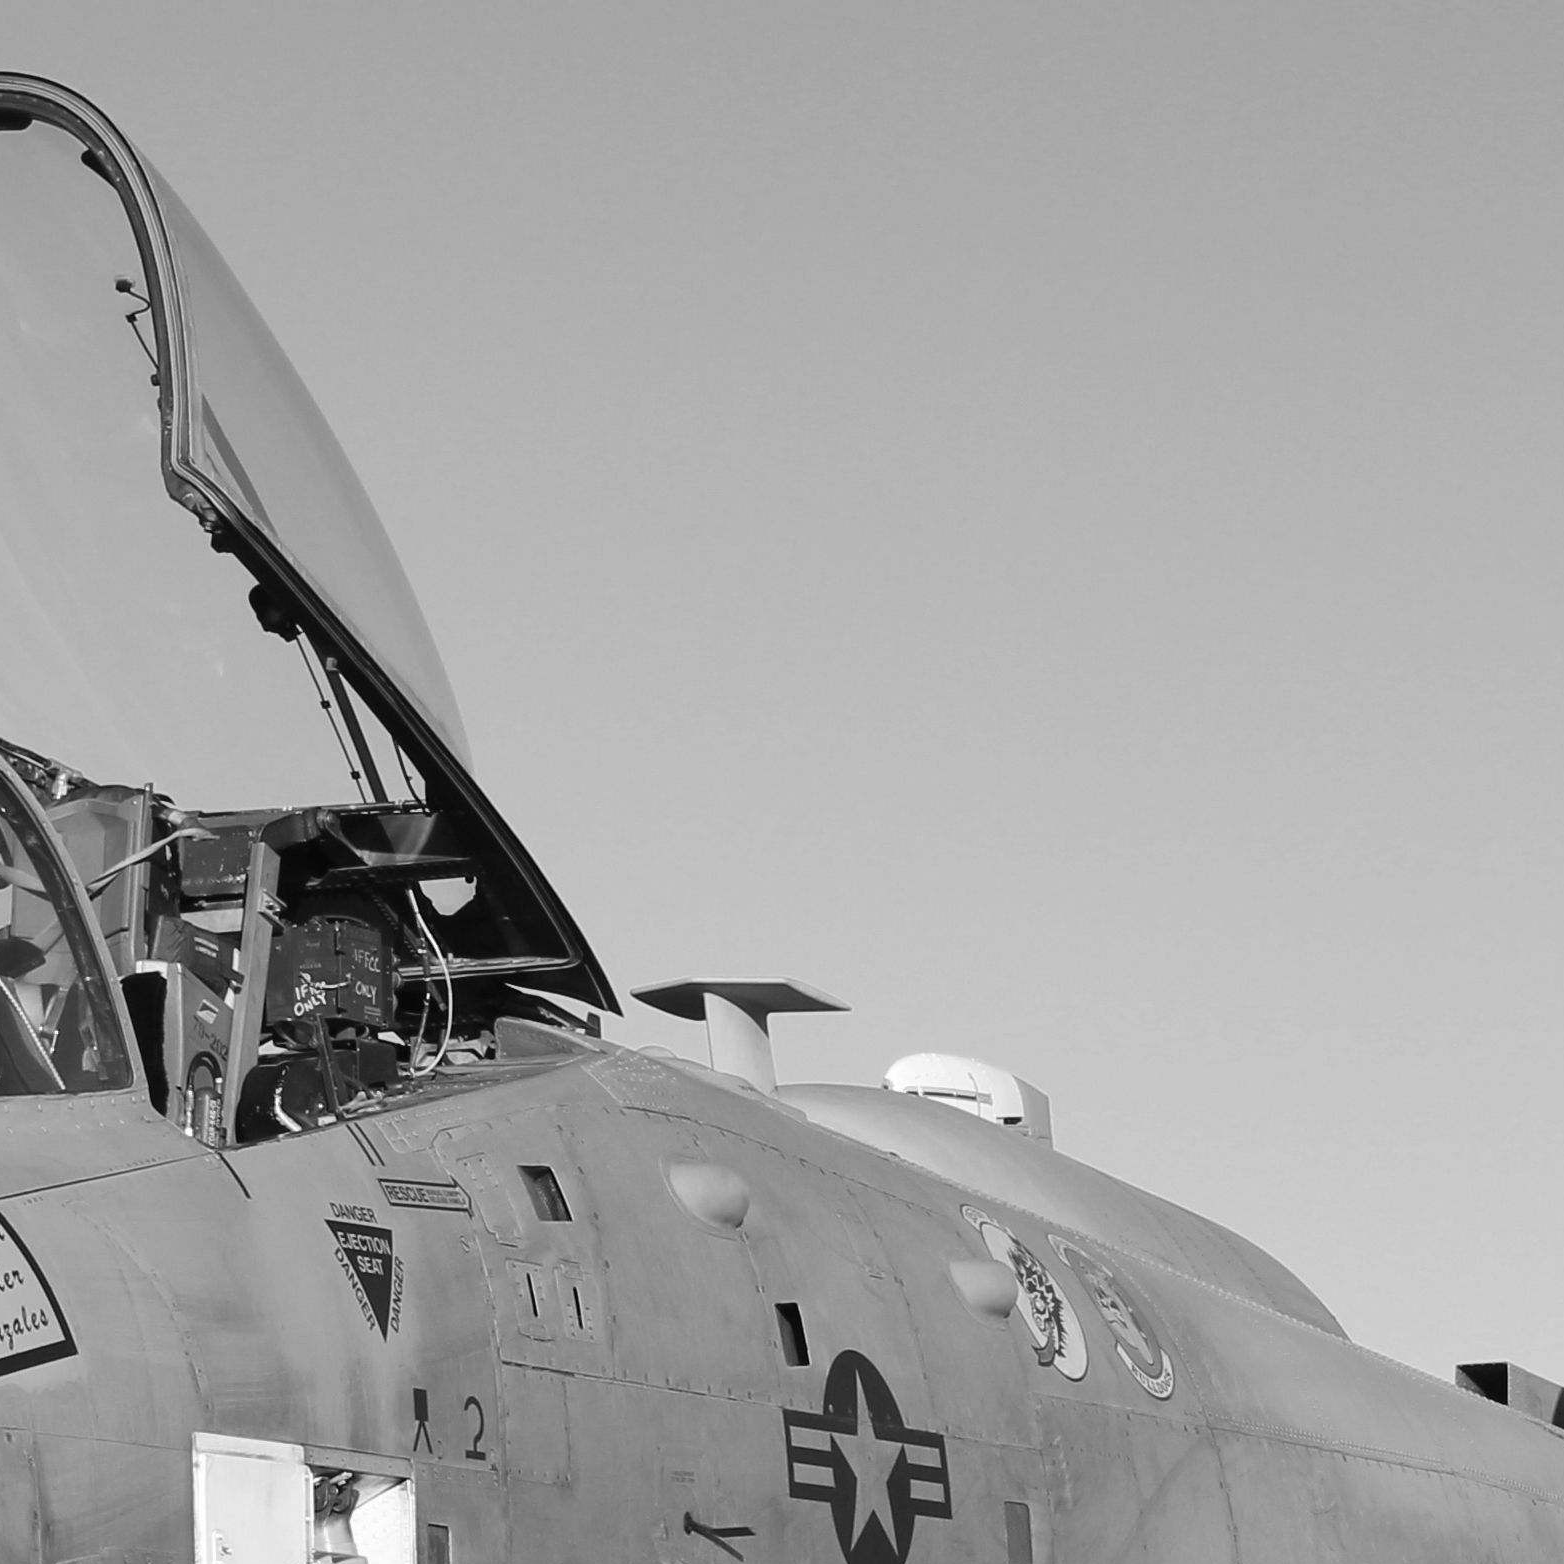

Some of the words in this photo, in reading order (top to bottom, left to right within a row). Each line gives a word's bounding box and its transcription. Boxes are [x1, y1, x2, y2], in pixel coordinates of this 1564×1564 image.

[294, 990, 327, 1016] ONLY
[355, 980, 377, 1005] ONLY
[385, 1185, 429, 1203] RESCUE
[330, 1202, 378, 1224] DANGER
[336, 1231, 392, 1256] EJECTION
[357, 1255, 384, 1275] SEAT
[334, 1246, 376, 1331] DANGER
[390, 1256, 404, 1333] DANGER
